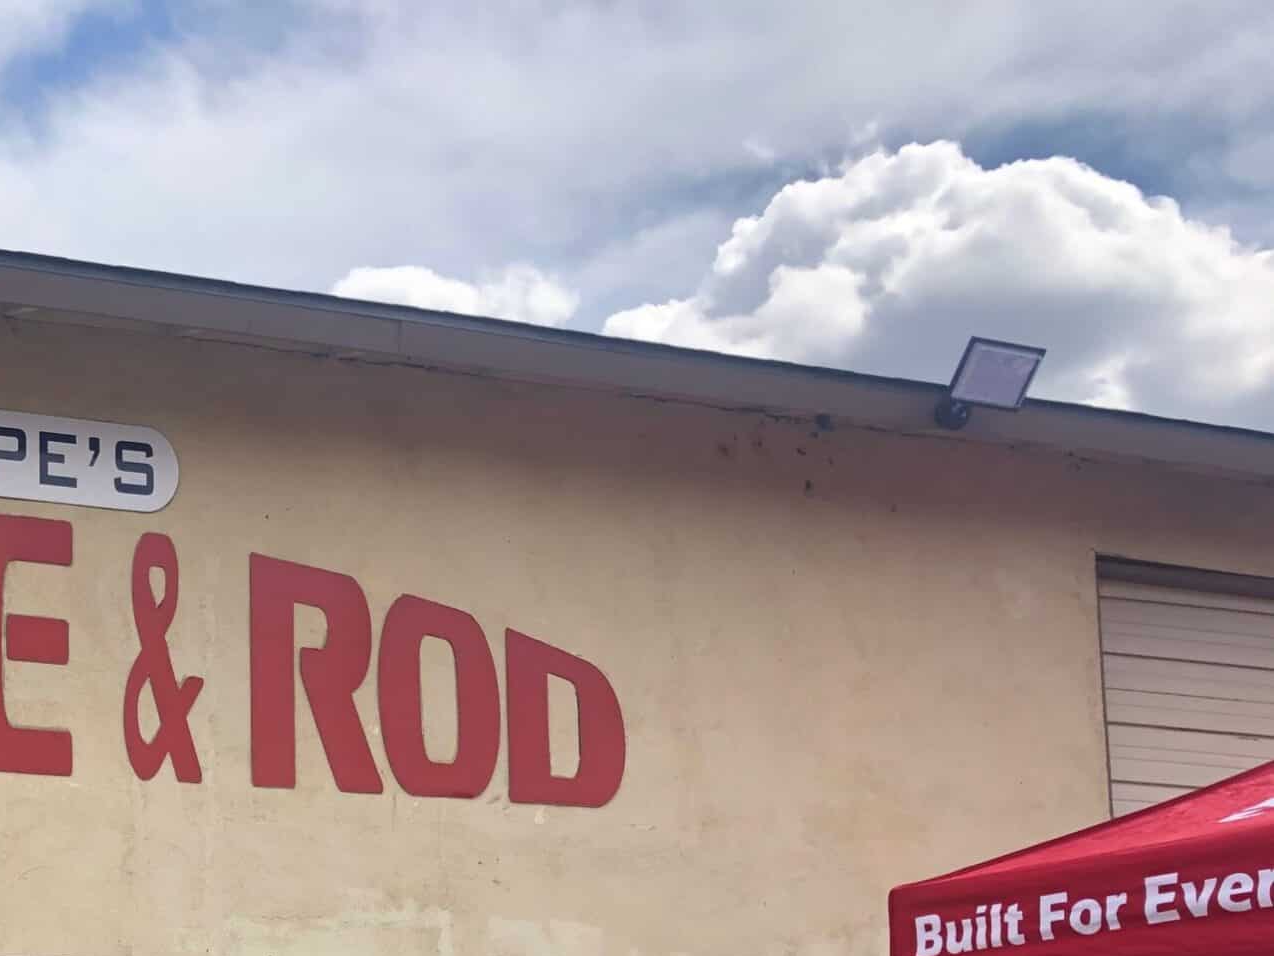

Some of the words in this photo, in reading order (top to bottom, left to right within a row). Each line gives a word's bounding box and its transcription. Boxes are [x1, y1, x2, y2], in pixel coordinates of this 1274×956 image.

[124, 532, 204, 784] &
[249, 552, 626, 808] ROD
[1039, 892, 1127, 941] For
